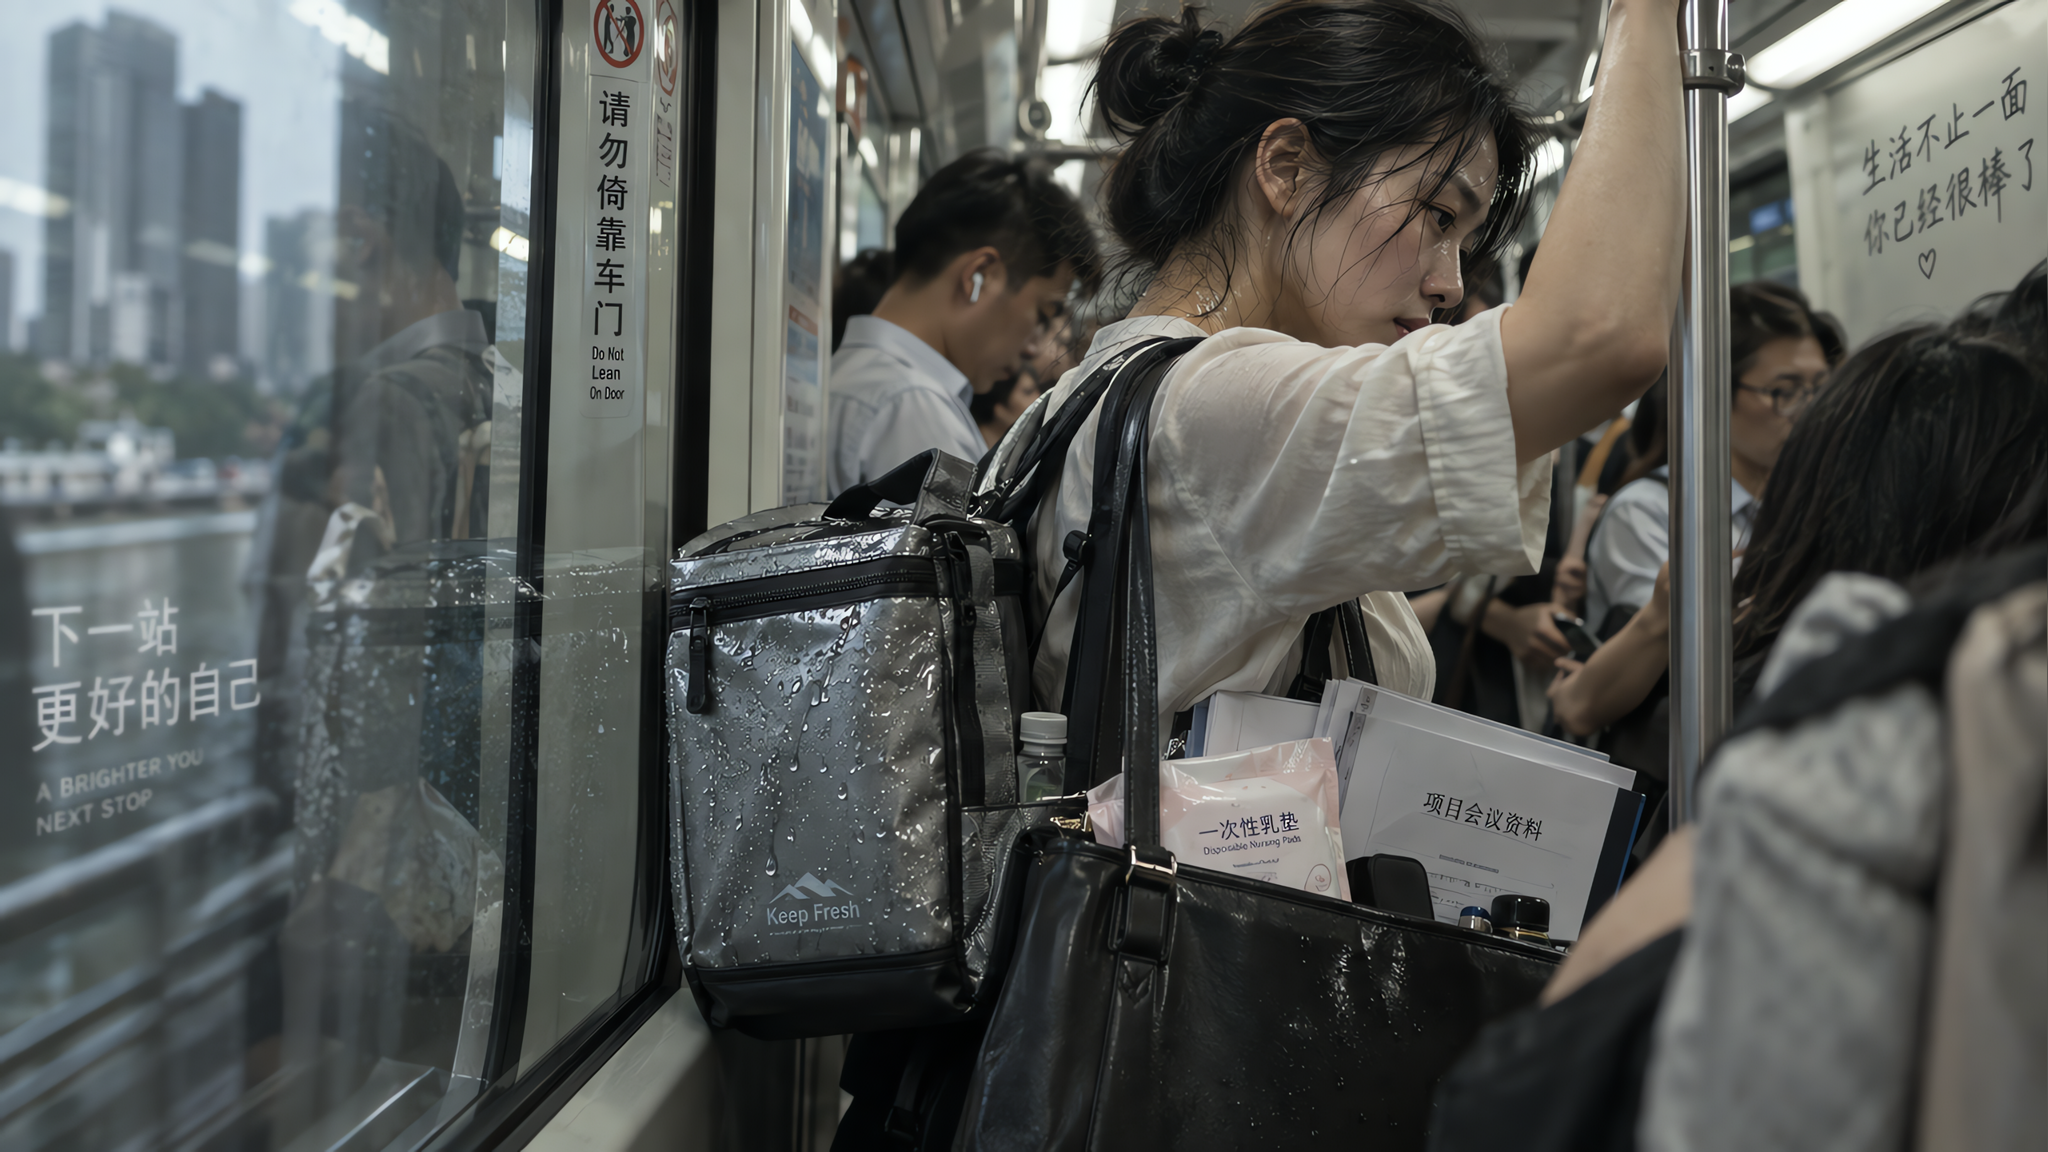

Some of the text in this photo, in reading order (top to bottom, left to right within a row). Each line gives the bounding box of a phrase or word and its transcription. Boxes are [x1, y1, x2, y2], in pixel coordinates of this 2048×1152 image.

[1862, 66, 2028, 196] 生活不止一面
[594, 90, 631, 338] 请勿倚靠车门
[1863, 138, 2035, 257] 你已经很棒了
[592, 346, 625, 361] Do Not
[592, 365, 621, 380] Lean
[590, 386, 625, 400] On Door
[32, 597, 179, 668] 下一站
[32, 658, 261, 752] 更好的自己
[35, 748, 204, 803] A BRIGHTER YOU
[36, 788, 153, 836] NEXT STOP
[1198, 811, 1300, 841] 一次性乳垫
[1423, 792, 1543, 842] 项目会议资料
[766, 900, 861, 927] Keep Fresh
